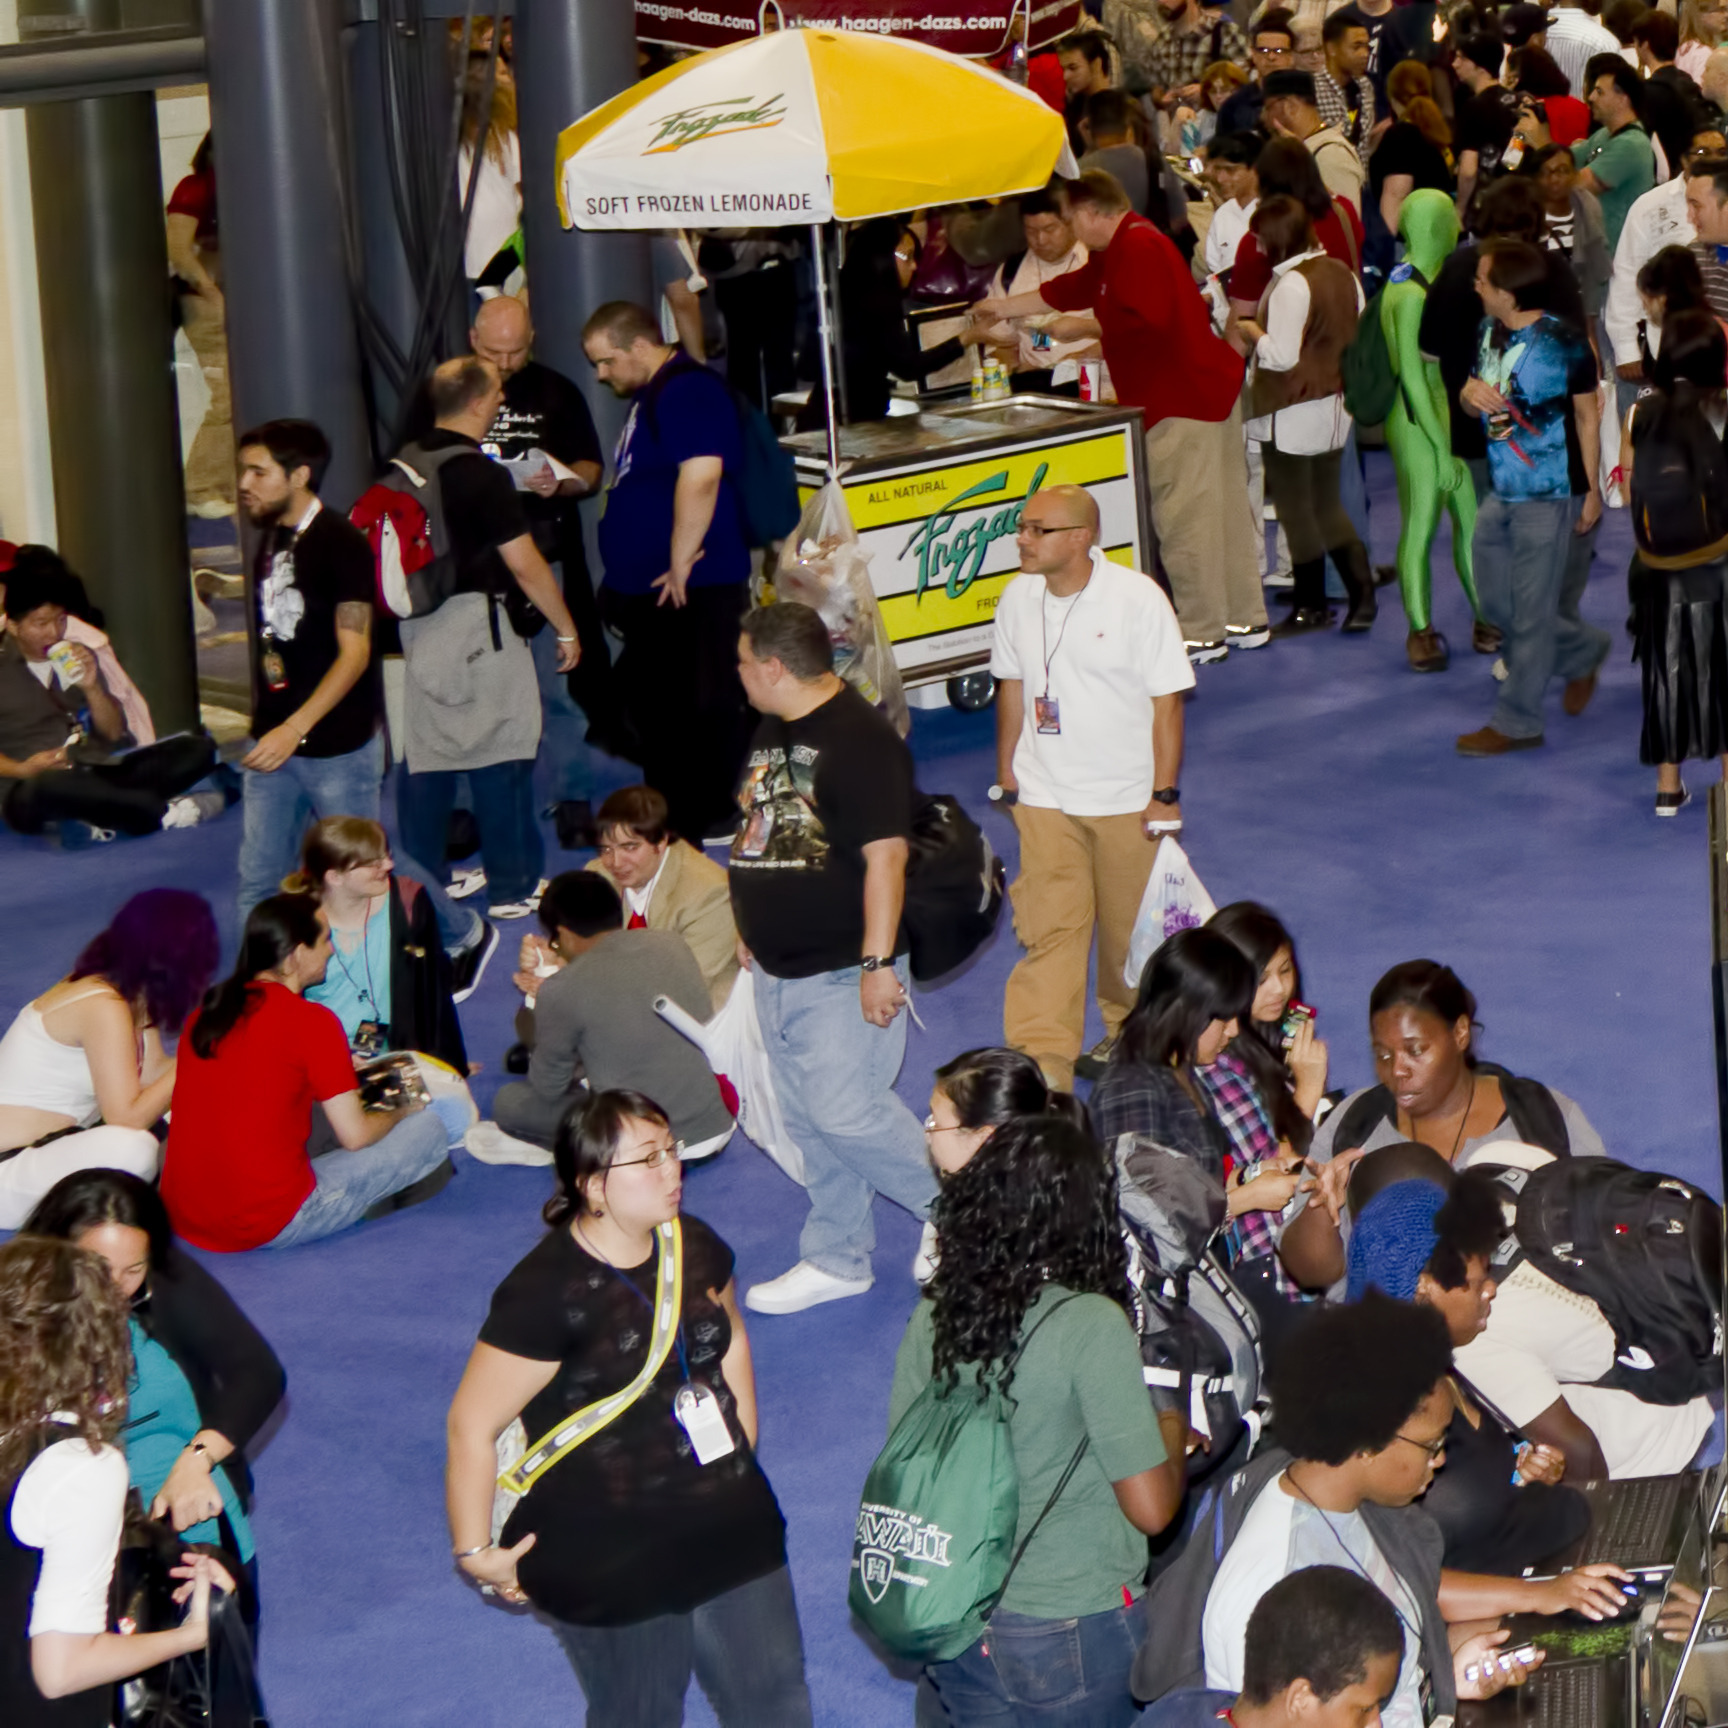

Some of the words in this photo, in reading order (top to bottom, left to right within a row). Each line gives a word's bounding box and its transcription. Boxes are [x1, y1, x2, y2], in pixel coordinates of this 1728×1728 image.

[586, 195, 630, 216] SOFT
[638, 194, 705, 214] FROZEN
[711, 192, 813, 212] LEMONADE
[868, 490, 892, 504] ALL
[893, 479, 948, 500] NATURAL
[898, 462, 1050, 607] Frozad
[976, 595, 1000, 612] FRO
[862, 1502, 907, 1520] IVERSITY
[908, 1514, 923, 1526] OF
[867, 1558, 888, 1586] H
